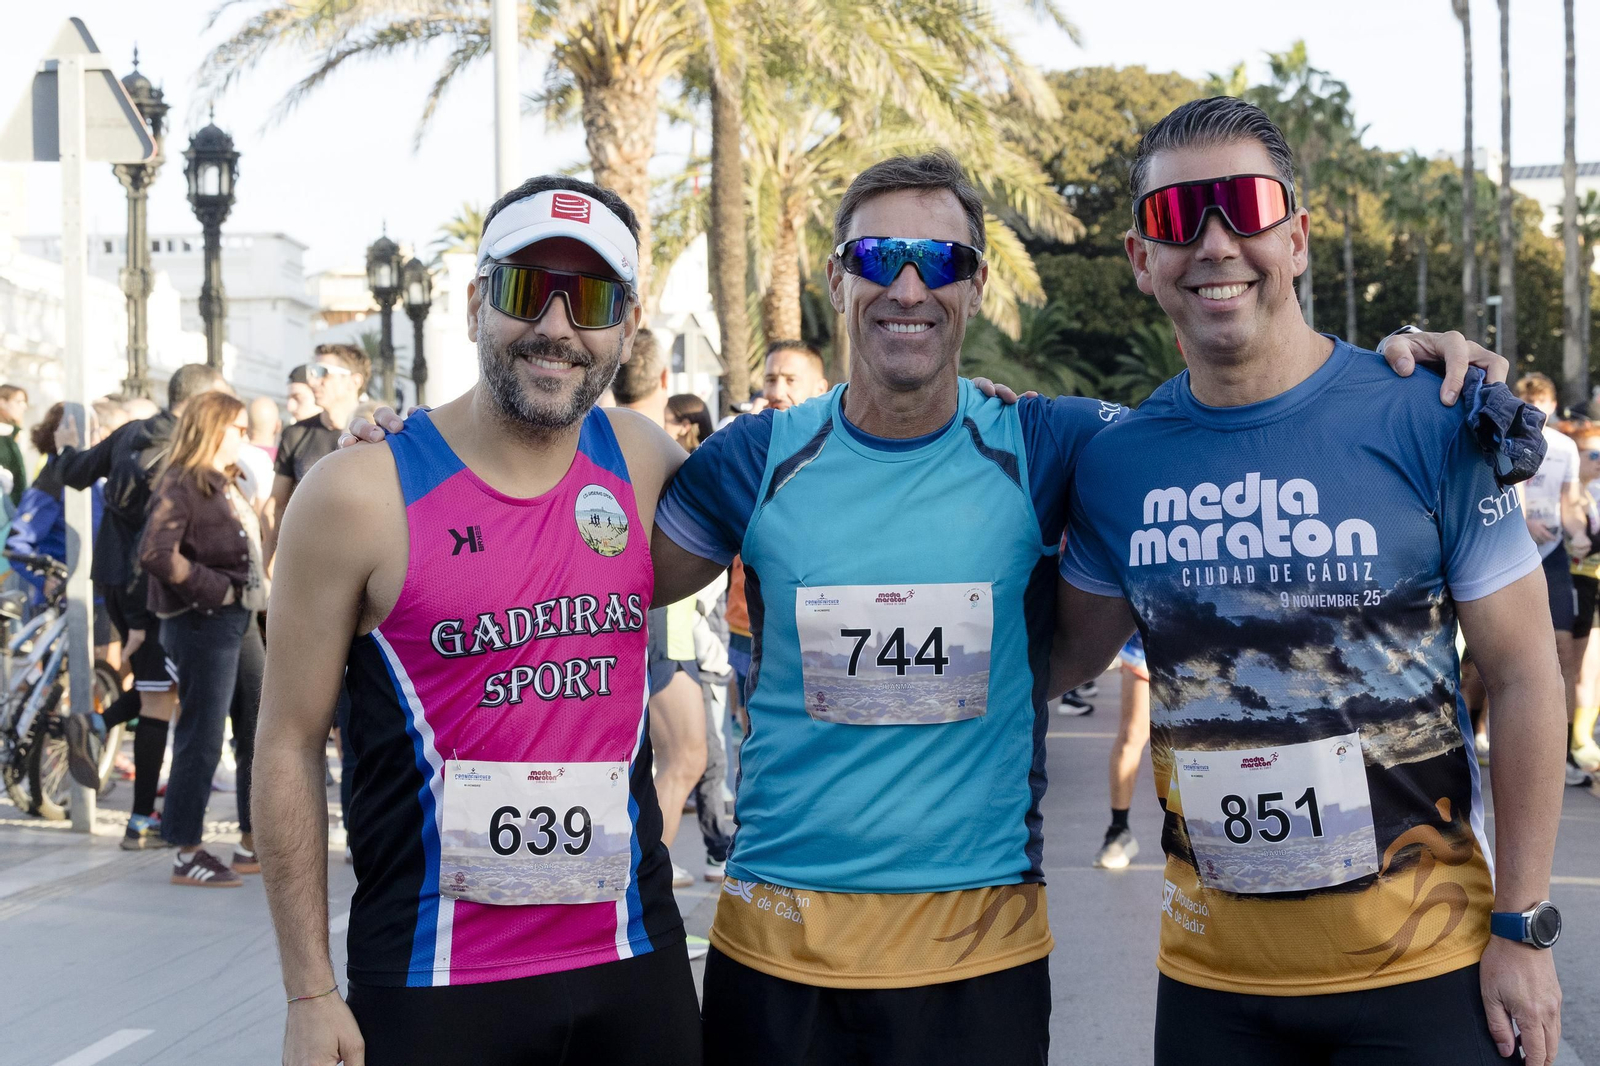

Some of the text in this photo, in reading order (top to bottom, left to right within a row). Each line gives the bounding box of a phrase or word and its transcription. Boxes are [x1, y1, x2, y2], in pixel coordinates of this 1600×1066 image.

[1143, 472, 1319, 524] media
[1477, 486, 1521, 527] Sm
[1182, 558, 1373, 587] CIUDAD DE CÁDIZ
[1280, 589, 1382, 608] 9 NOVIEMBRE 25
[430, 591, 645, 657] GADEIRAS
[840, 626, 949, 676] 744
[477, 656, 617, 707] SPORT
[489, 805, 592, 856] 639
[1220, 787, 1323, 844] 851
[757, 896, 772, 911] de
